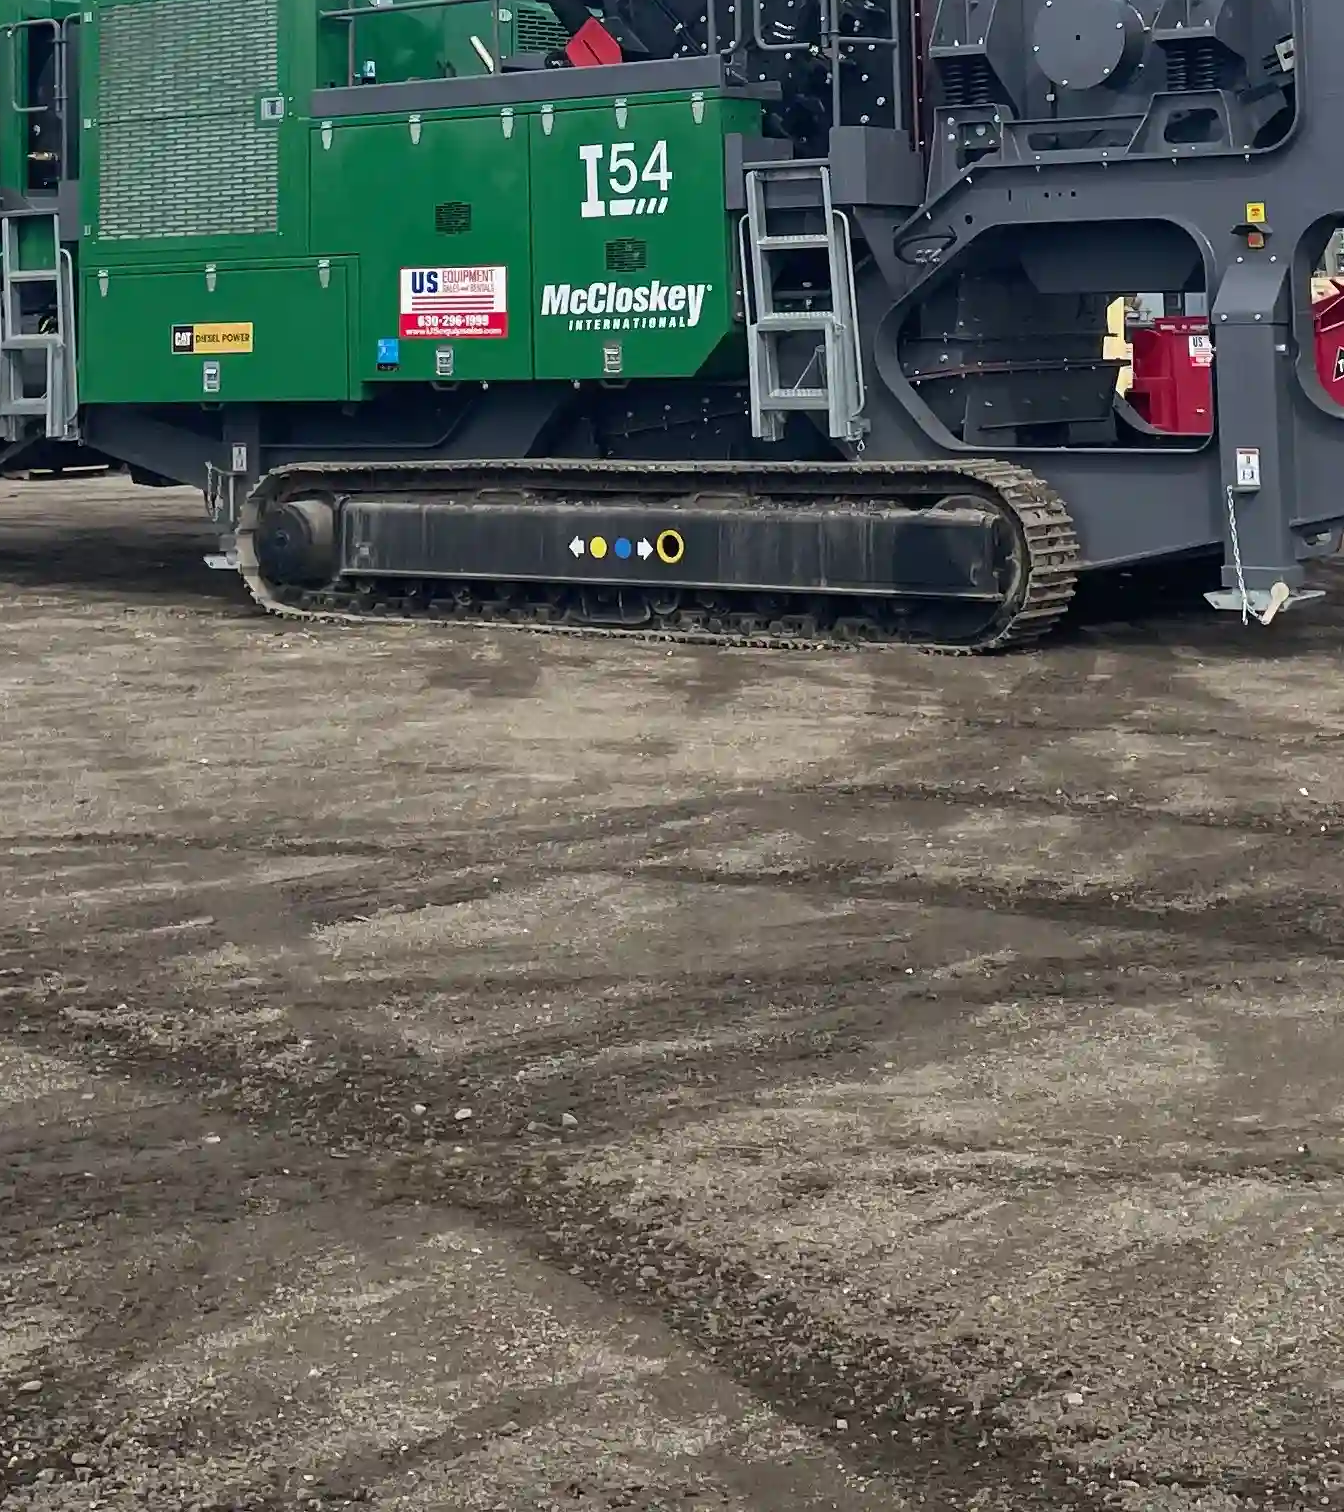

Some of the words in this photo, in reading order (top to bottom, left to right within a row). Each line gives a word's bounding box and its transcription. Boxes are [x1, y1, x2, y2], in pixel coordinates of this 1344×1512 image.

[412, 271, 438, 294] US
[442, 269, 495, 283] EQUIPMENT
[541, 280, 705, 327] McCloskey
[568, 316, 686, 331] INTERNATIONAL
[175, 332, 192, 346] CAT
[196, 333, 220, 343] DIESEL
[222, 333, 250, 343] POWER
[1192, 336, 1203, 347] US
